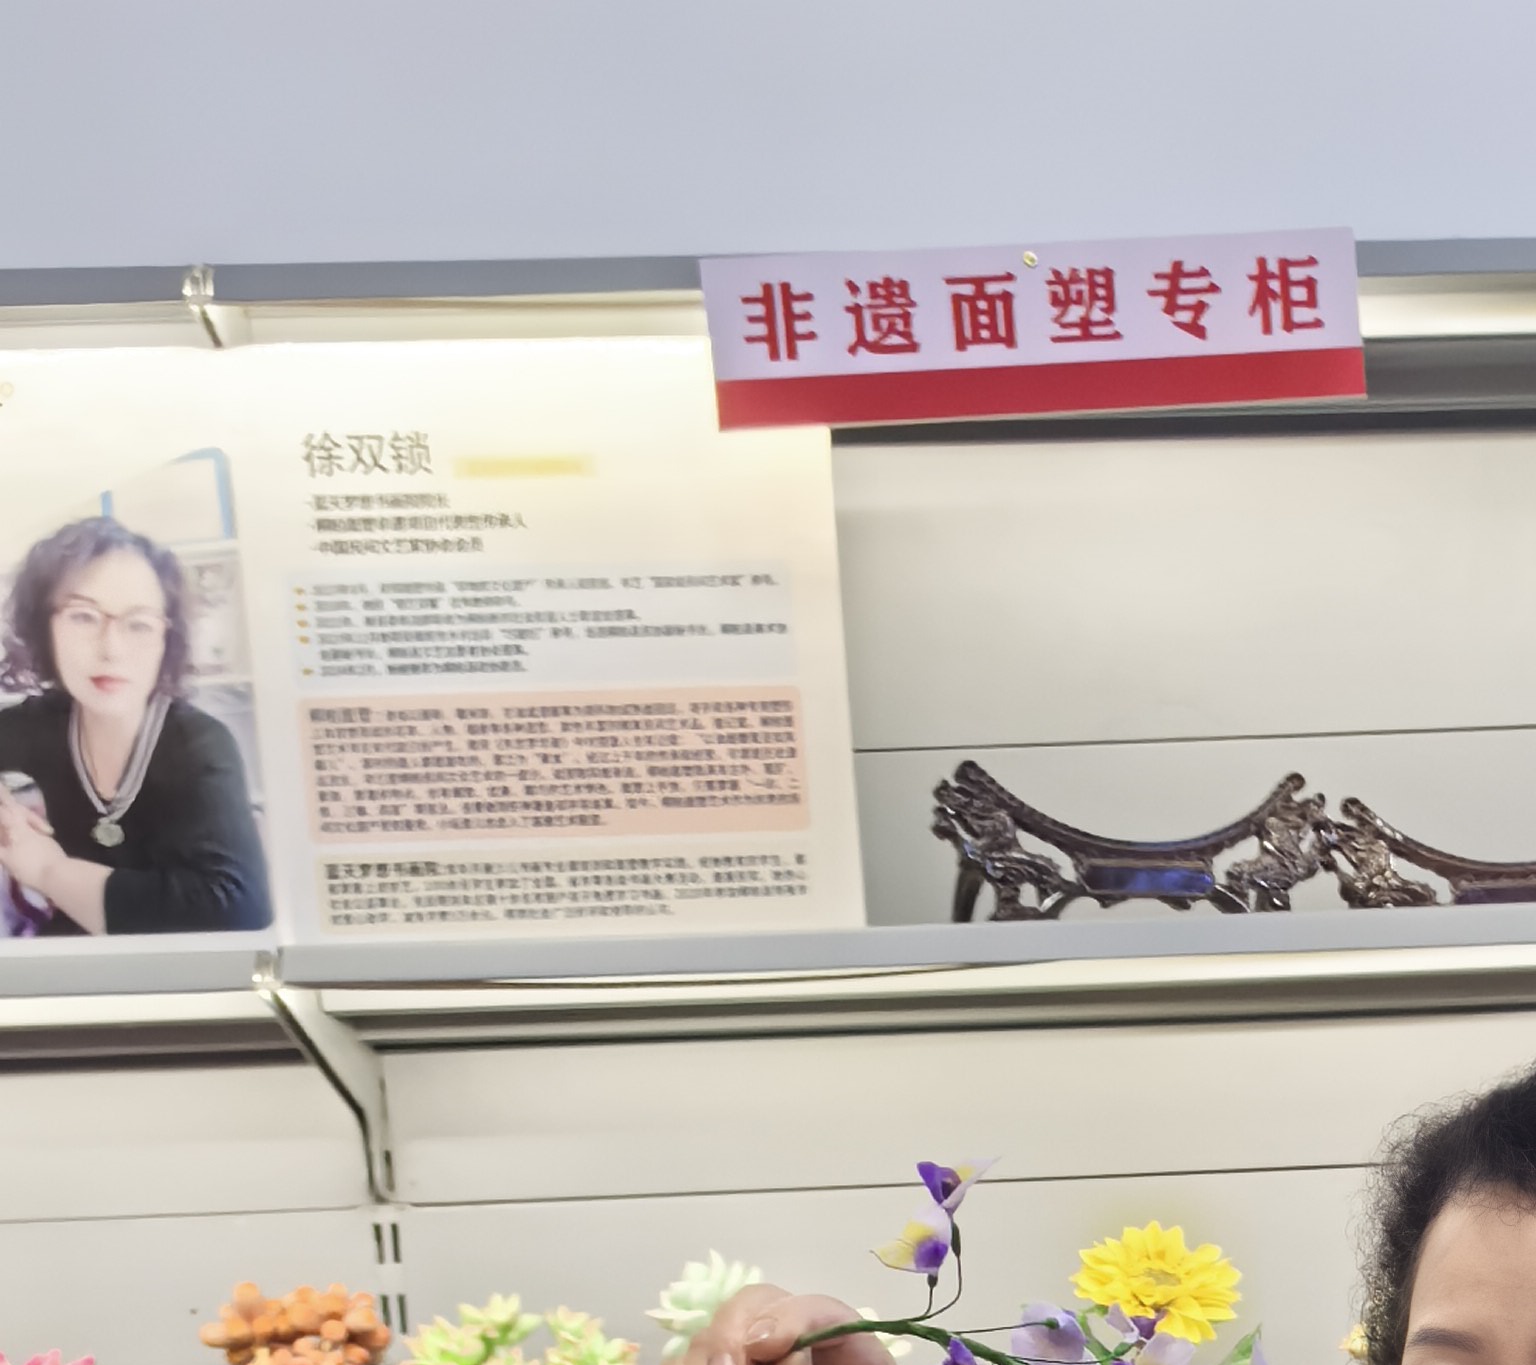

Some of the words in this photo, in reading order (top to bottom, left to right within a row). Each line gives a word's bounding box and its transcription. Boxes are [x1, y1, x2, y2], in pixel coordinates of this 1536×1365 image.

[740, 254, 1326, 362] 非遗面塑专柜
[301, 430, 434, 478] 徐双锁
